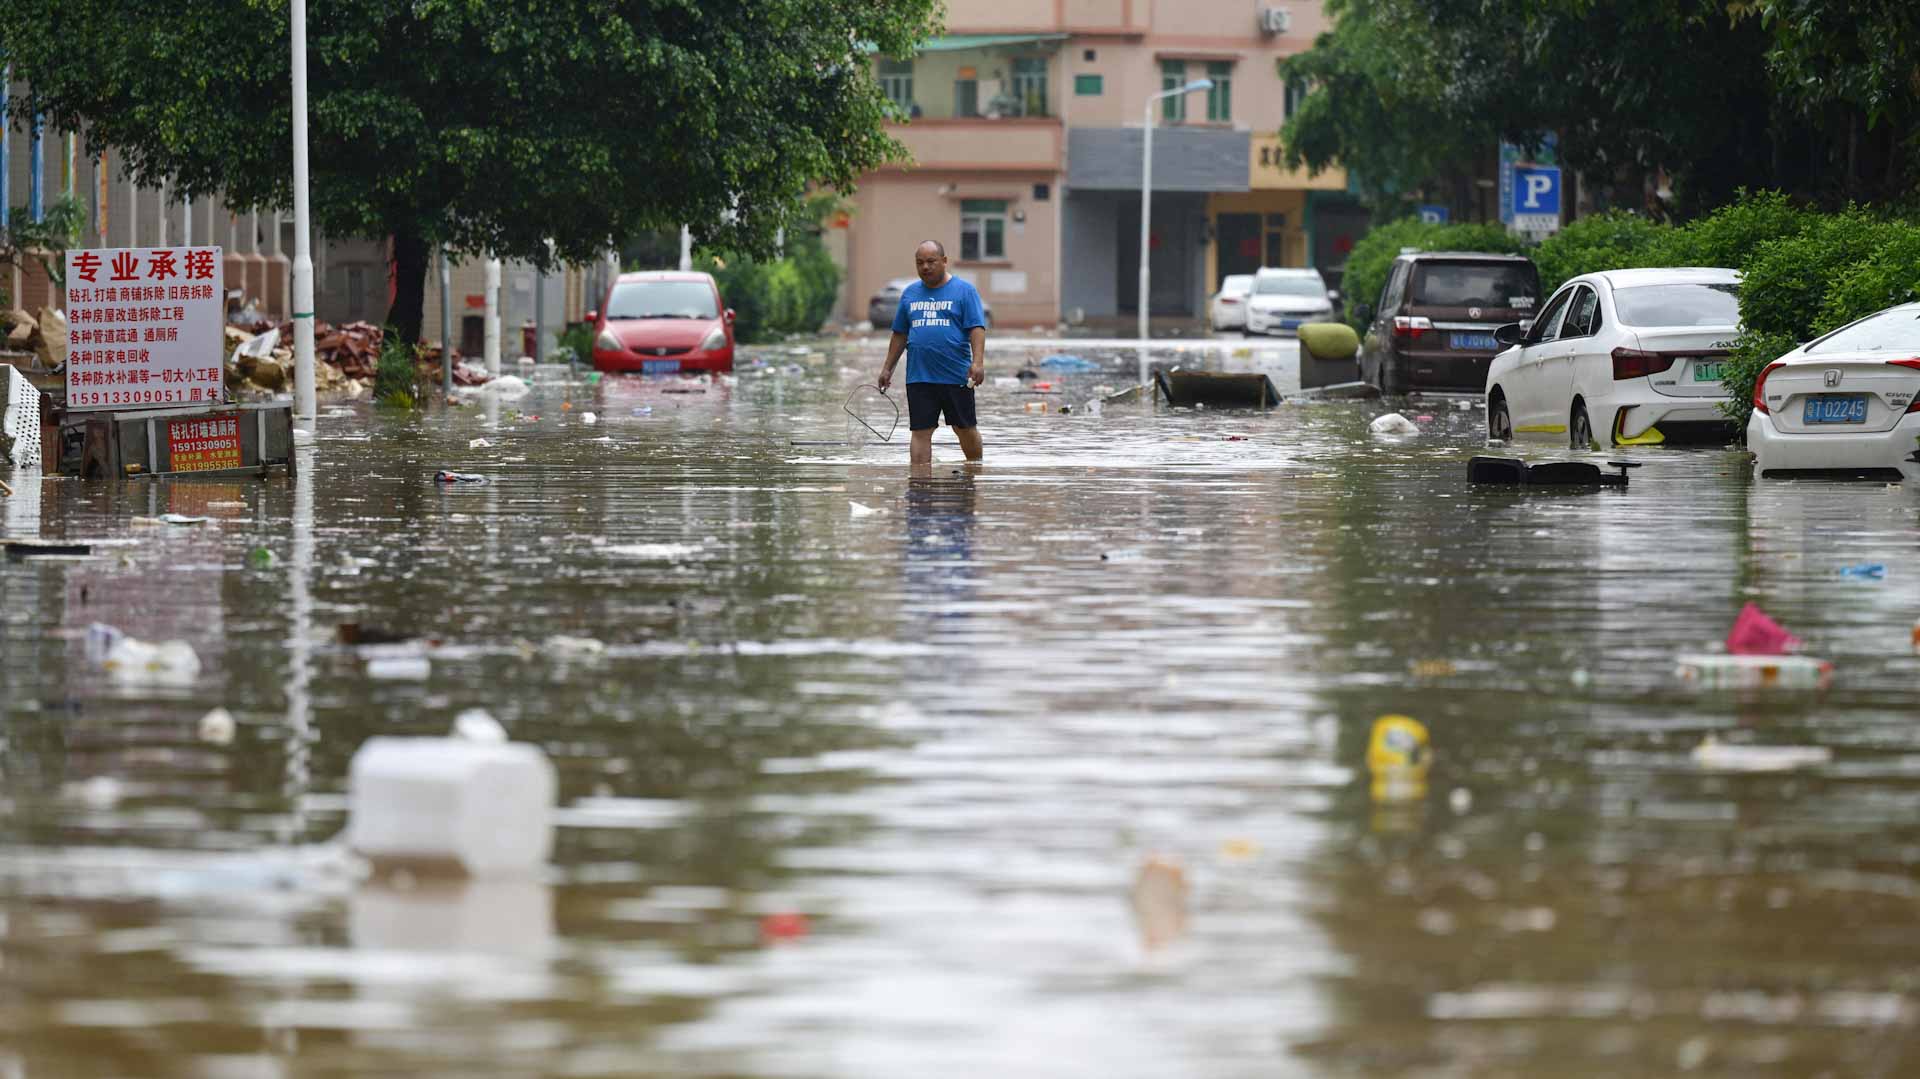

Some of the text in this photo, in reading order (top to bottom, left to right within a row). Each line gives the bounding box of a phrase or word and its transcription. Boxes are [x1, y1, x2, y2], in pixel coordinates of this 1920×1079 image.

[1523, 175, 1552, 208] P
[72, 250, 215, 283] 专业承接
[69, 284, 213, 303] 钻孔 打墙 商铺拆除 旧房拆除
[70, 306, 185, 324] 各种房屋改造拆除工程
[910, 301, 953, 312] WORKOUT
[926, 318, 951, 327] BATTLE
[70, 327, 178, 345] 各种管道疏通 通厕所
[70, 348, 150, 365] 各种旧家电回收
[70, 367, 219, 386] 各种防水补漏等一切大小工程
[71, 389, 182, 405] 15913309051
[1825, 401, 1864, 417] 02245
[173, 439, 237, 453] 15913309051
